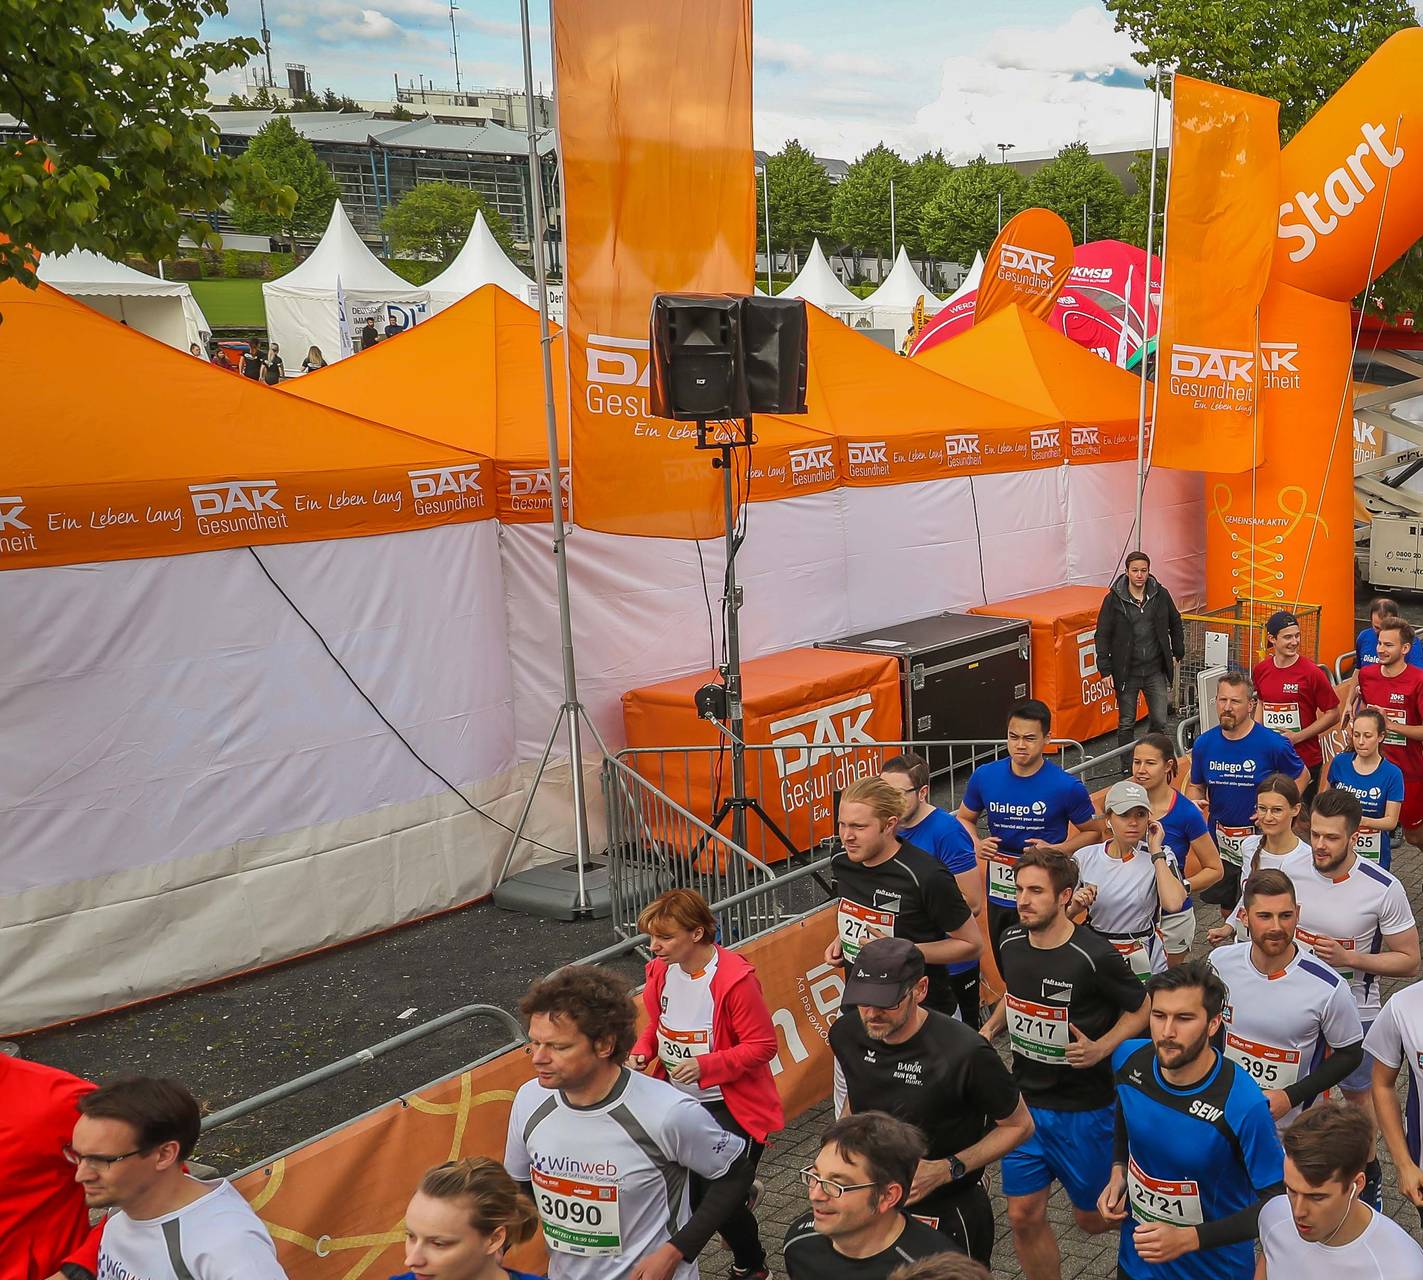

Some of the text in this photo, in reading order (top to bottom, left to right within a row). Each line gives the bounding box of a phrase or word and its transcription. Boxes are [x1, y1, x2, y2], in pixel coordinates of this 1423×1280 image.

[1277, 121, 1404, 263] Start
[1001, 244, 1056, 278] DAK
[1171, 343, 1256, 383] DAK
[1170, 376, 1253, 402] Gesundheit
[1263, 373, 1300, 389] dheit
[634, 422, 661, 438] Ein
[667, 424, 704, 440] Lebe
[1030, 428, 1060, 449] DAK
[1071, 427, 1099, 446] DAK
[847, 441, 888, 464] DAK
[945, 434, 980, 455] DAK
[1031, 447, 1062, 461] Gesundheit
[789, 445, 834, 472] DAK
[893, 451, 906, 463] Ein
[908, 449, 927, 463] Leben
[947, 455, 982, 468] Gesundheit
[792, 468, 836, 486] Gesundheit
[849, 463, 891, 477] Gesundheit
[408, 463, 484, 499] DAK
[188, 480, 284, 516] DAK
[295, 494, 322, 511] Ein
[328, 490, 368, 510] Leben
[414, 491, 485, 516] Gesundheit
[48, 512, 82, 531] Ein
[90, 507, 140, 530] Leben
[197, 511, 289, 536] Gesundheit
[1266, 518, 1289, 527] AKTIV
[1213, 633, 1220, 642] 2
[1363, 654, 1380, 664] Diale
[1267, 713, 1293, 725] 2896
[770, 693, 879, 779] DAK
[1209, 760, 1242, 774] Dialego
[813, 803, 832, 821] Ein
[989, 801, 1030, 816] Dialego
[1356, 836, 1373, 848] 65
[997, 867, 1015, 882] 12
[1014, 1015, 1057, 1040] 2717
[664, 1040, 693, 1060] 394
[1240, 1056, 1278, 1083] 395
[1189, 1100, 1223, 1122] SEW
[548, 1156, 617, 1177] Winweb
[540, 1194, 602, 1226] 3090
[1134, 1183, 1184, 1217] 2721
